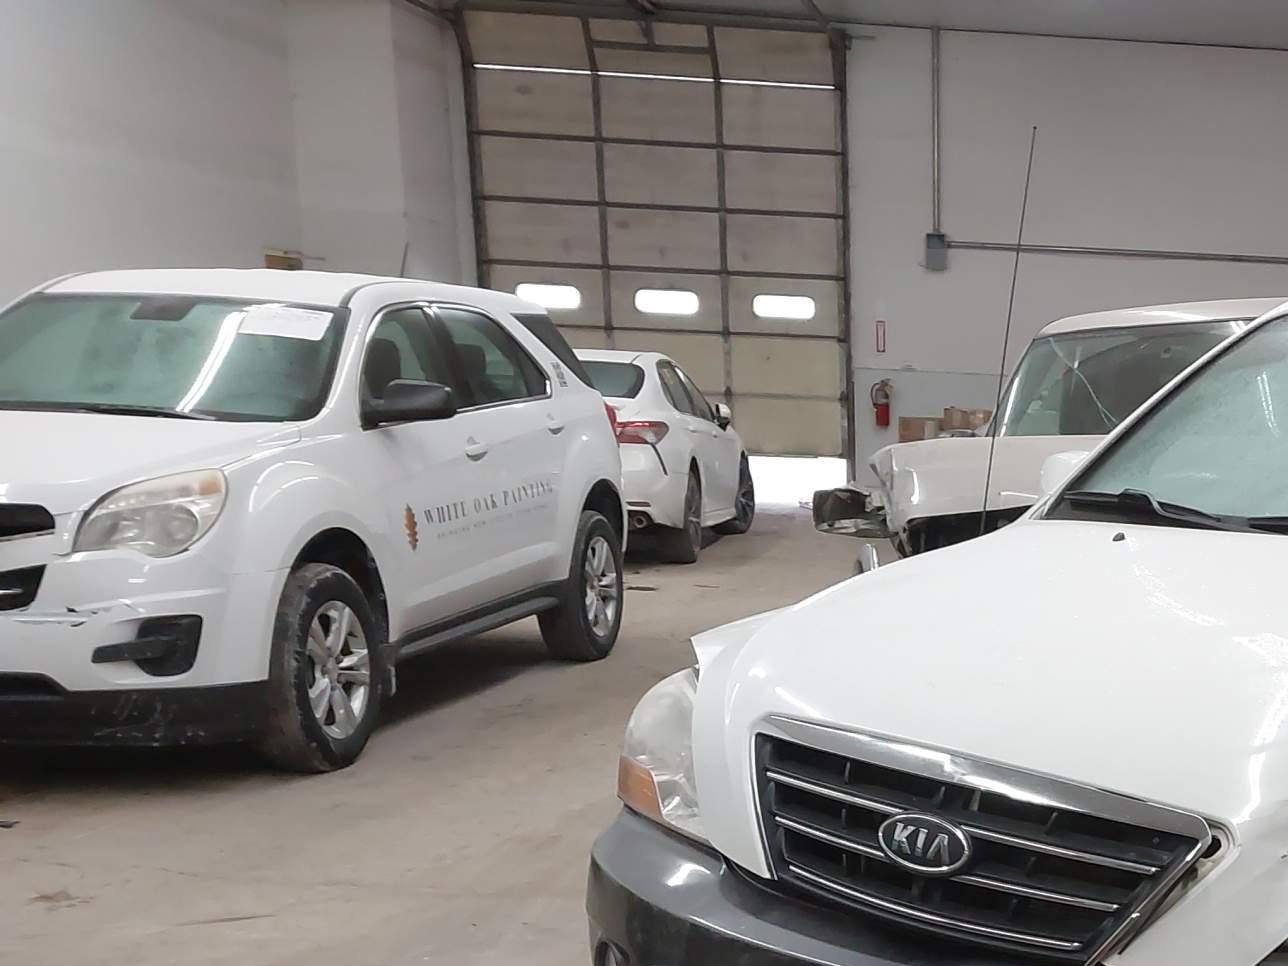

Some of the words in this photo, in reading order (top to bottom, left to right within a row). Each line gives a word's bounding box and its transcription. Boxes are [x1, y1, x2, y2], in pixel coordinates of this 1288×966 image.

[424, 501, 468, 525] WHITE
[473, 493, 498, 513] OAK
[891, 822, 950, 865] KIA
